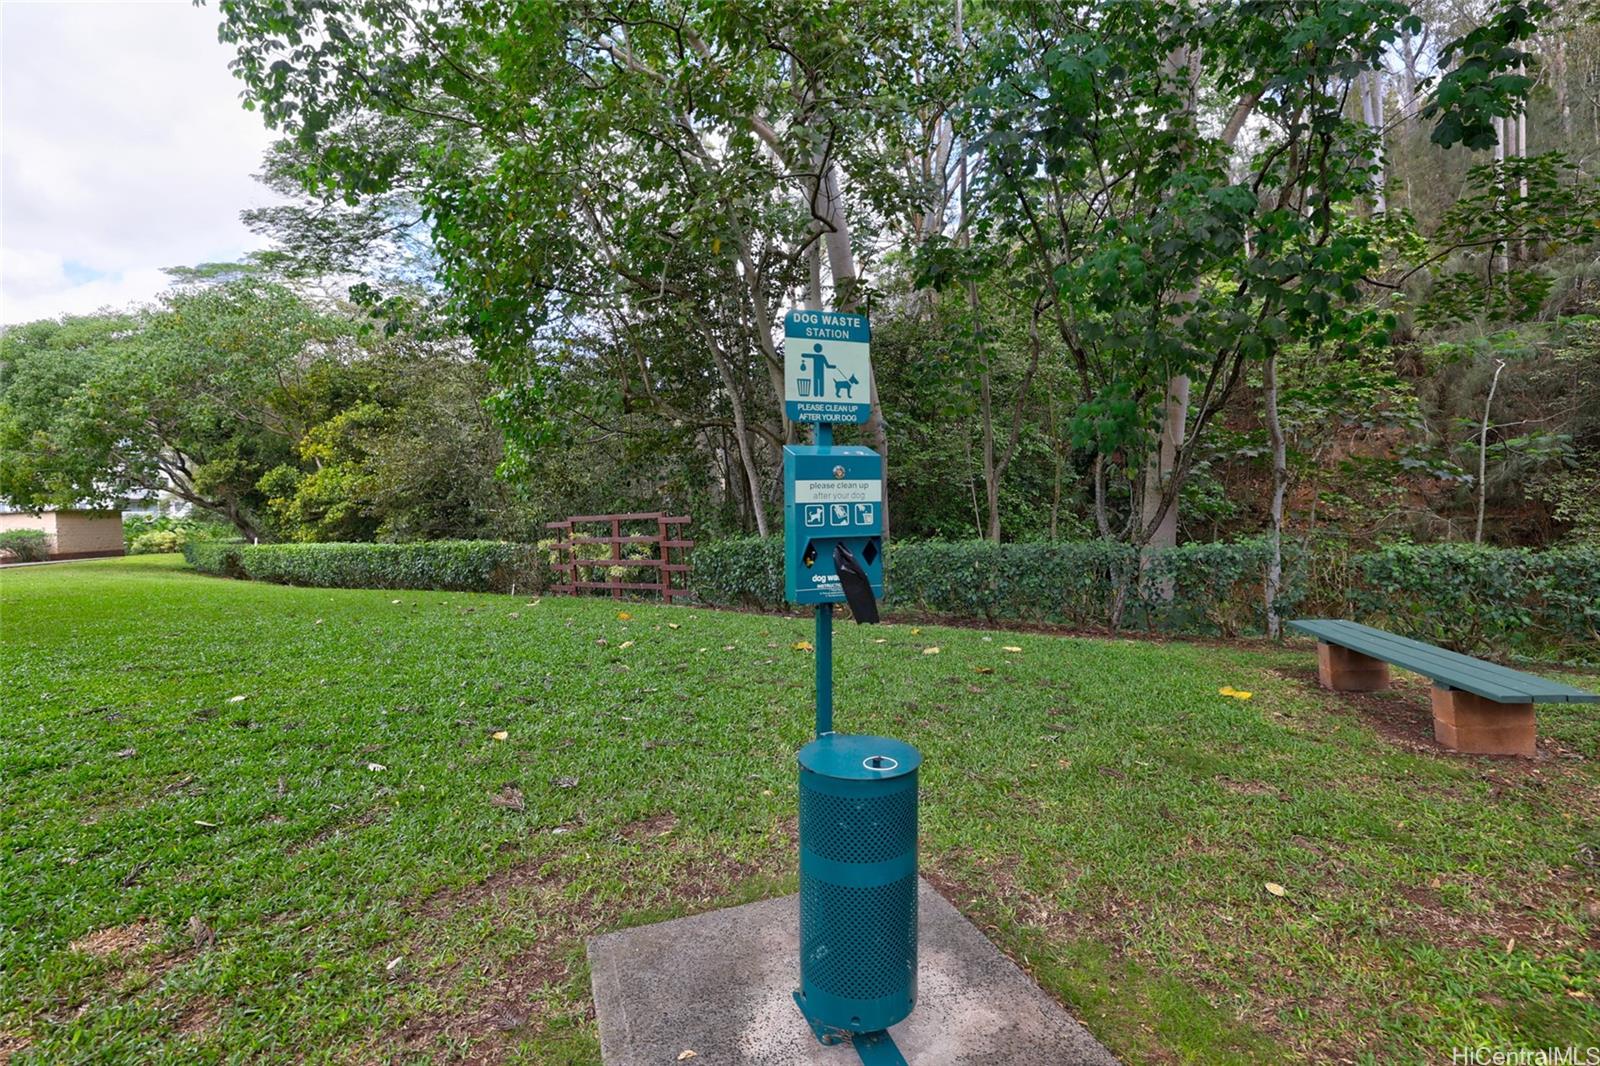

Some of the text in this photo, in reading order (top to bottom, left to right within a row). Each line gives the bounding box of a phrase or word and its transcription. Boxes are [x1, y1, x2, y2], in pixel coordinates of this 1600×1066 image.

[794, 313, 860, 327] DOG WASTE
[806, 327, 849, 339] STATION
[851, 491, 865, 500] dog
[812, 574, 826, 583] dog
